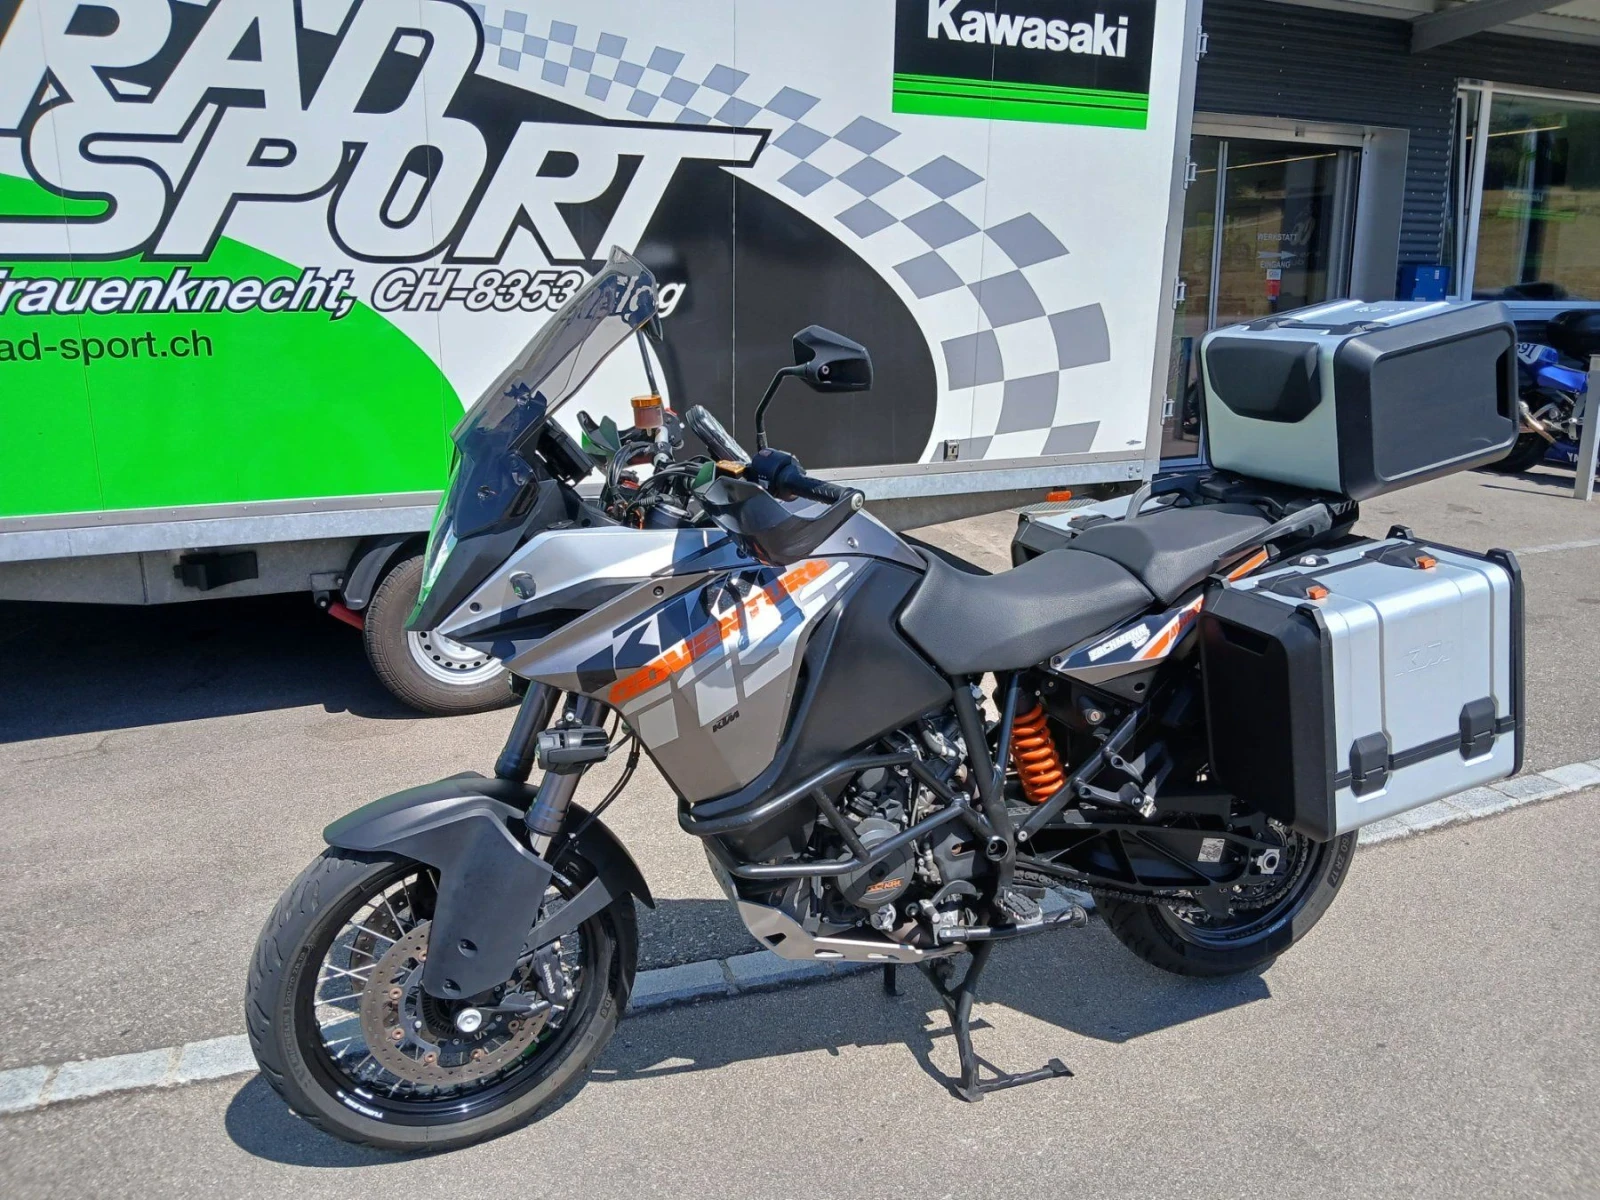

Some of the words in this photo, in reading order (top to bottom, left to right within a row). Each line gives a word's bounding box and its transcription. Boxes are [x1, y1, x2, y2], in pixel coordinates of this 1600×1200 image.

[926, 0, 1129, 58] Kawasaki
[1257, 232, 1298, 242] WERKSTATT
[1260, 260, 1292, 270] EINGANG
[712, 710, 740, 733] KTM
[542, 962, 557, 995] brembo
